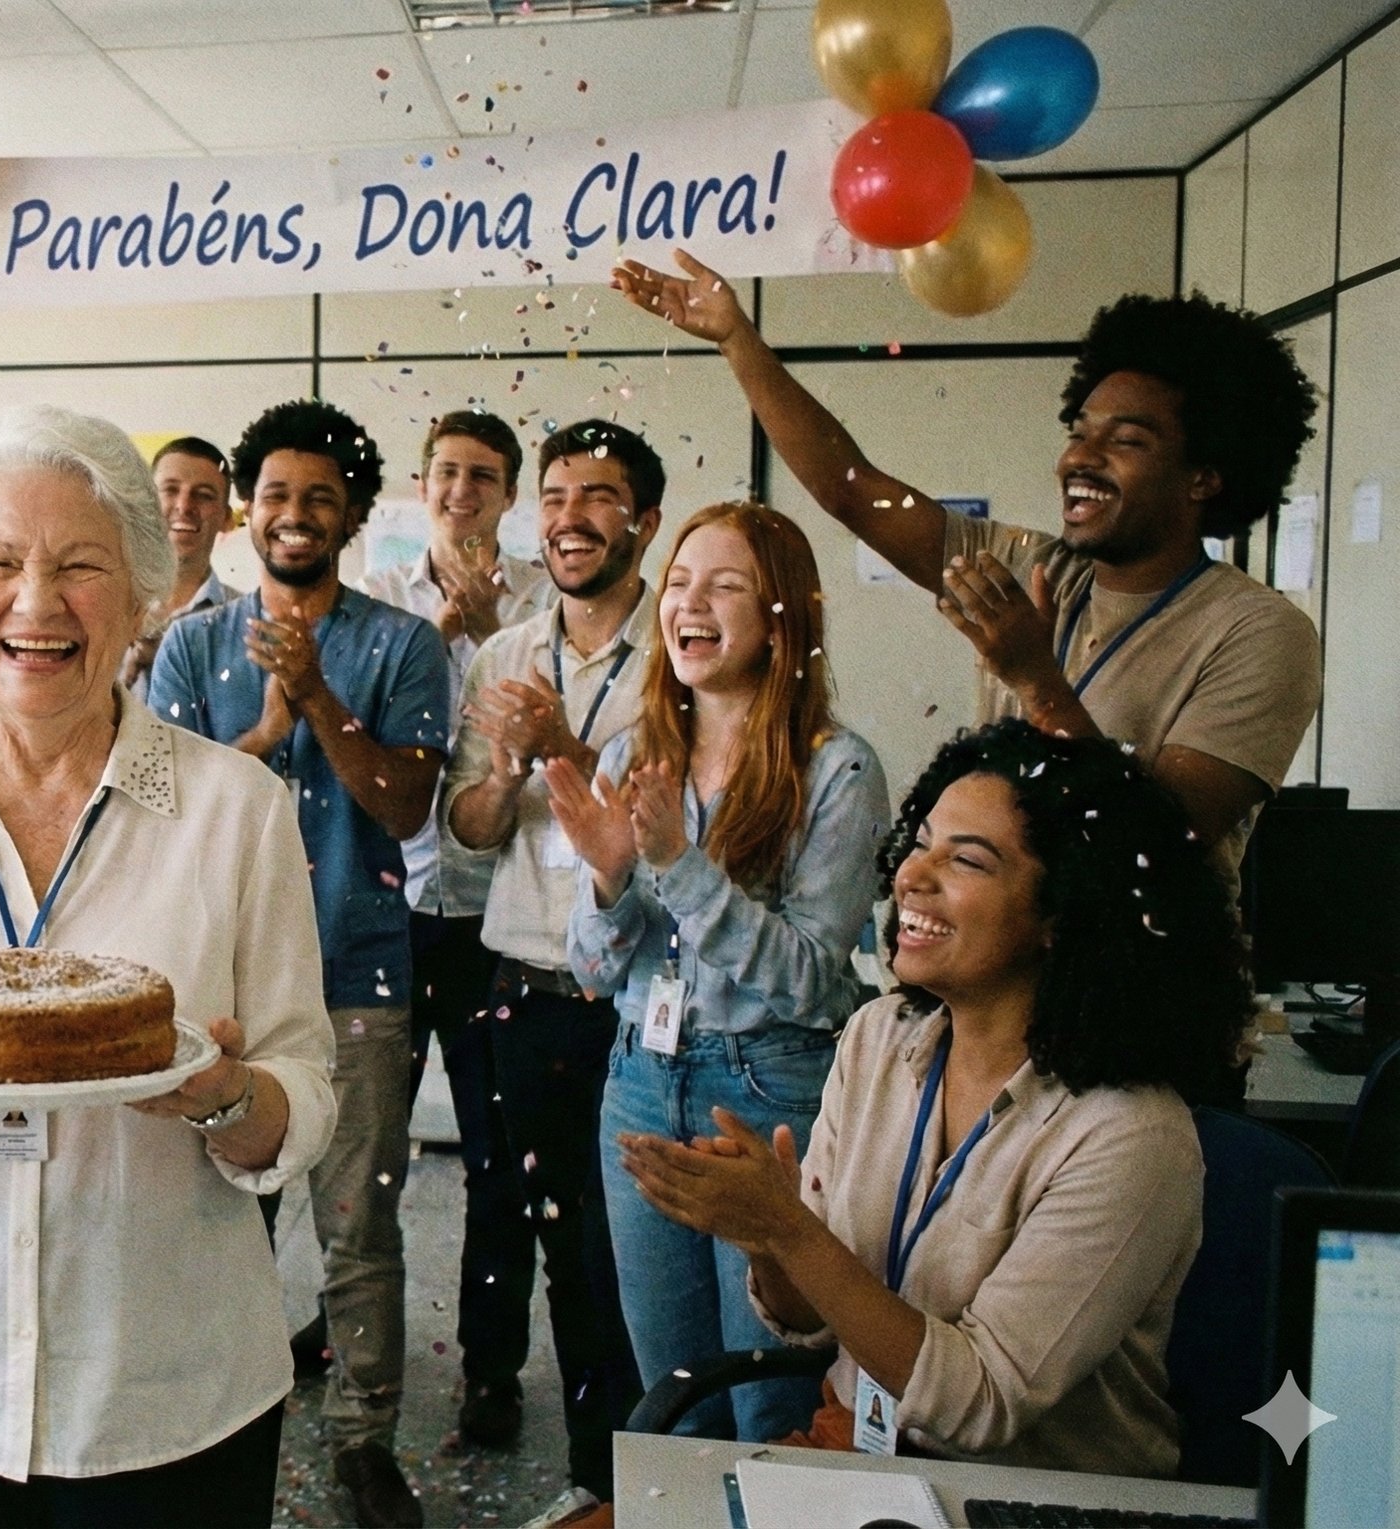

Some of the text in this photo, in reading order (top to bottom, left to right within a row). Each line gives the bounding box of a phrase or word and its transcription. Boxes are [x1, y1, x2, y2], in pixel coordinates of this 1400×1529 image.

[5, 150, 787, 275] Parabéns, Dona Clara!
